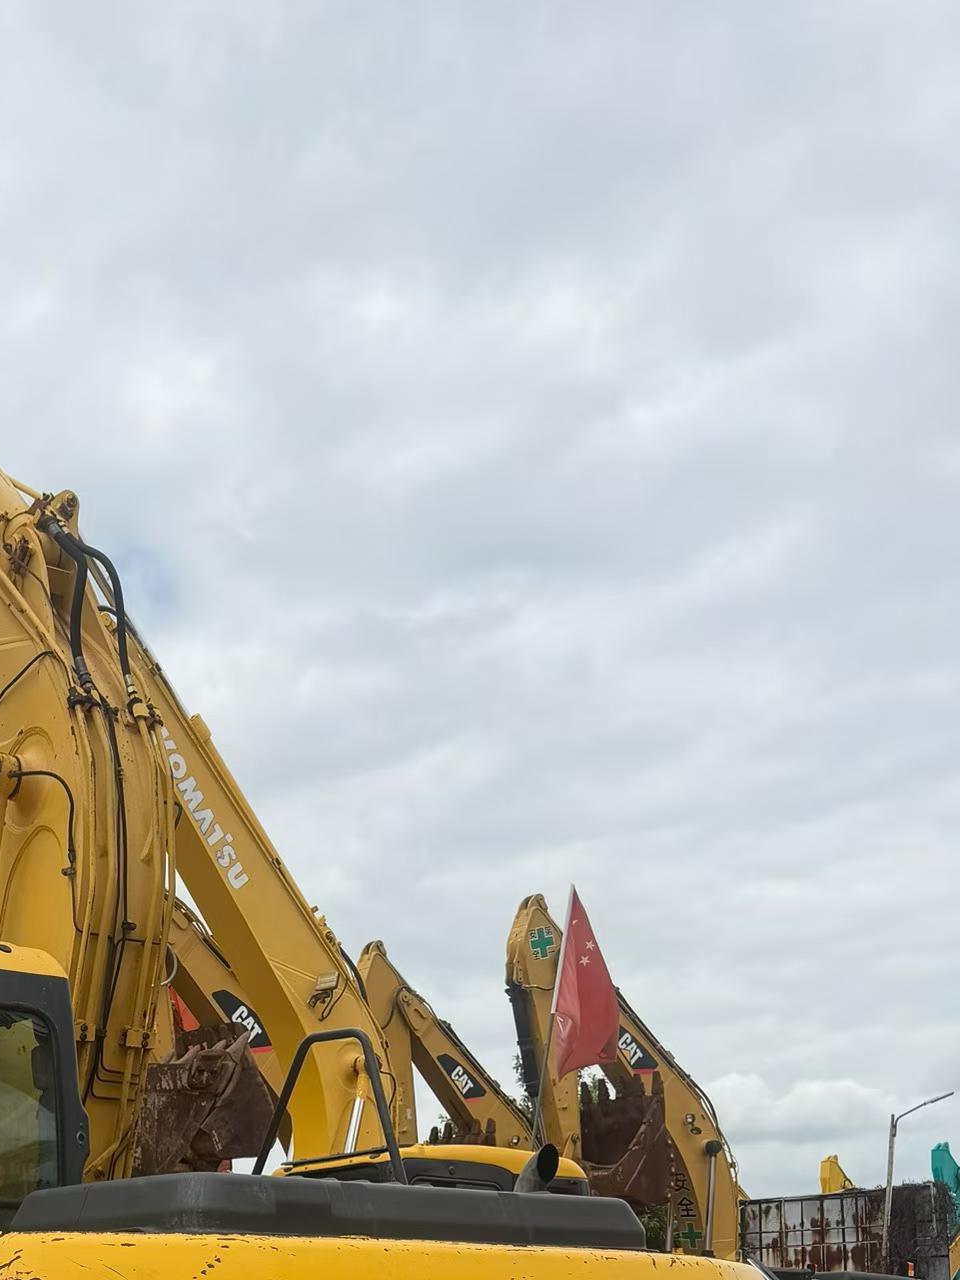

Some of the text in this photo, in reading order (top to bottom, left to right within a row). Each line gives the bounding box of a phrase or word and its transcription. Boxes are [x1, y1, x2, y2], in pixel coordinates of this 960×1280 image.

[231, 1005, 263, 1043] CAT
[618, 1032, 644, 1066] CAT
[451, 1065, 474, 1095] CAT
[672, 1172, 697, 1217] 安全
